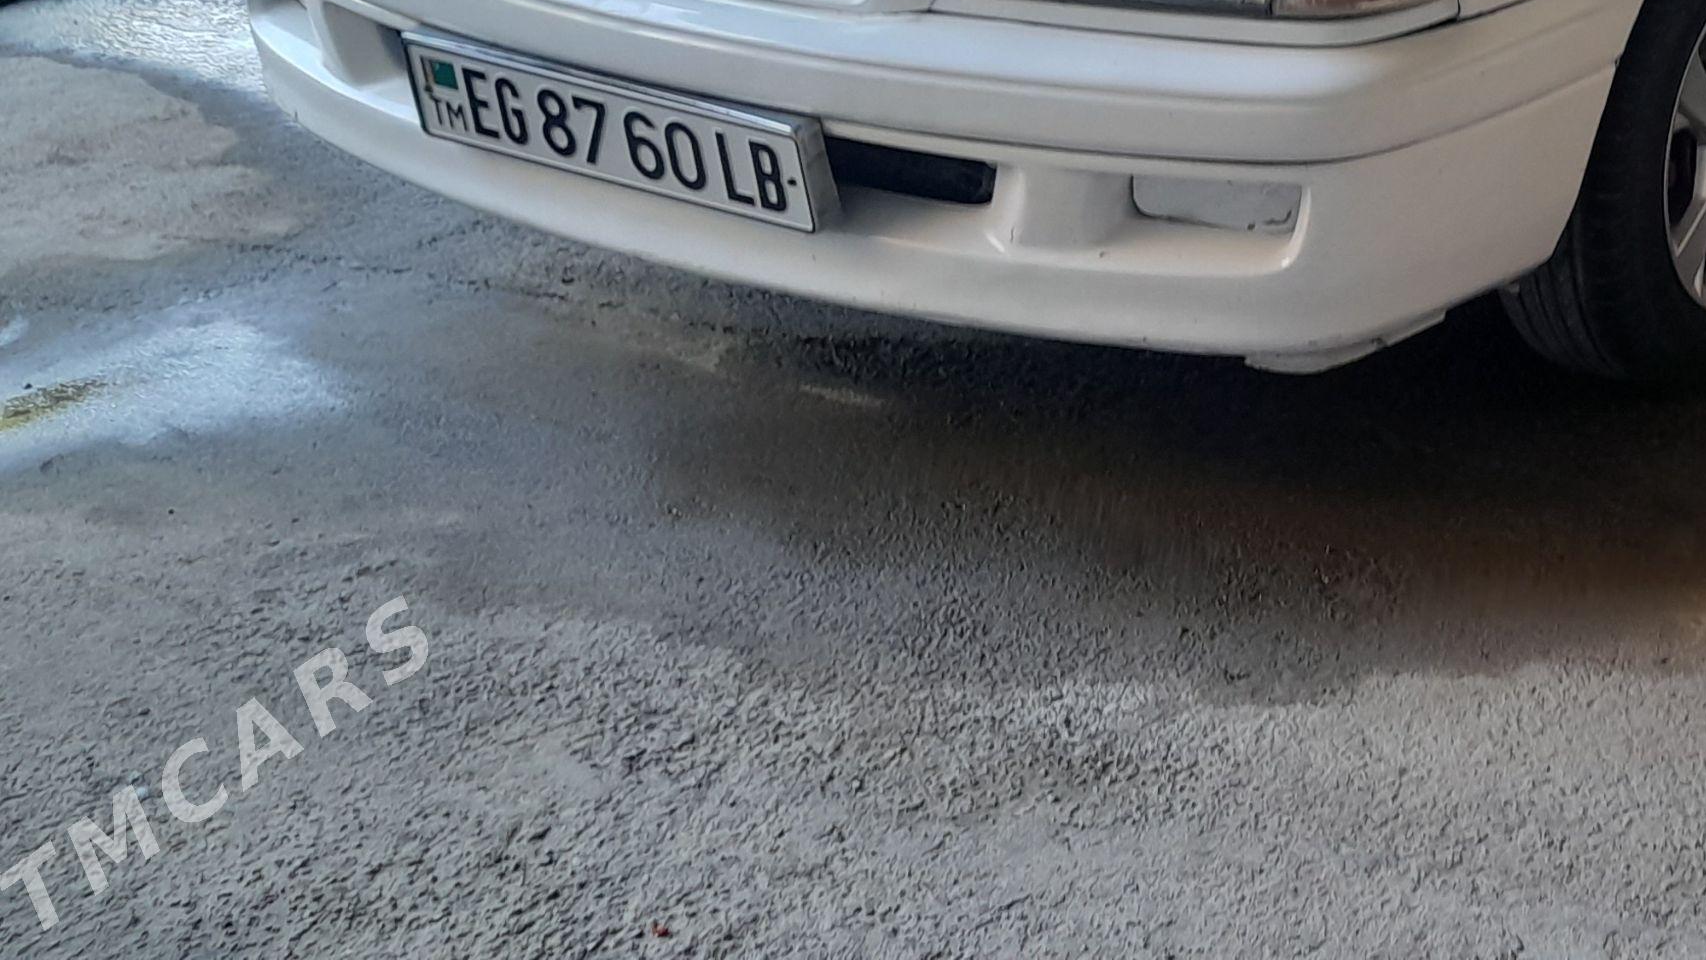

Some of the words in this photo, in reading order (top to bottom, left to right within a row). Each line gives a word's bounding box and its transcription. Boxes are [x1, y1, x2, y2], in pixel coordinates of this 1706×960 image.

[431, 96, 469, 133] TM
[461, 66, 529, 146] EG
[536, 88, 606, 166] 87
[623, 110, 707, 191] 60
[714, 129, 788, 212] LB
